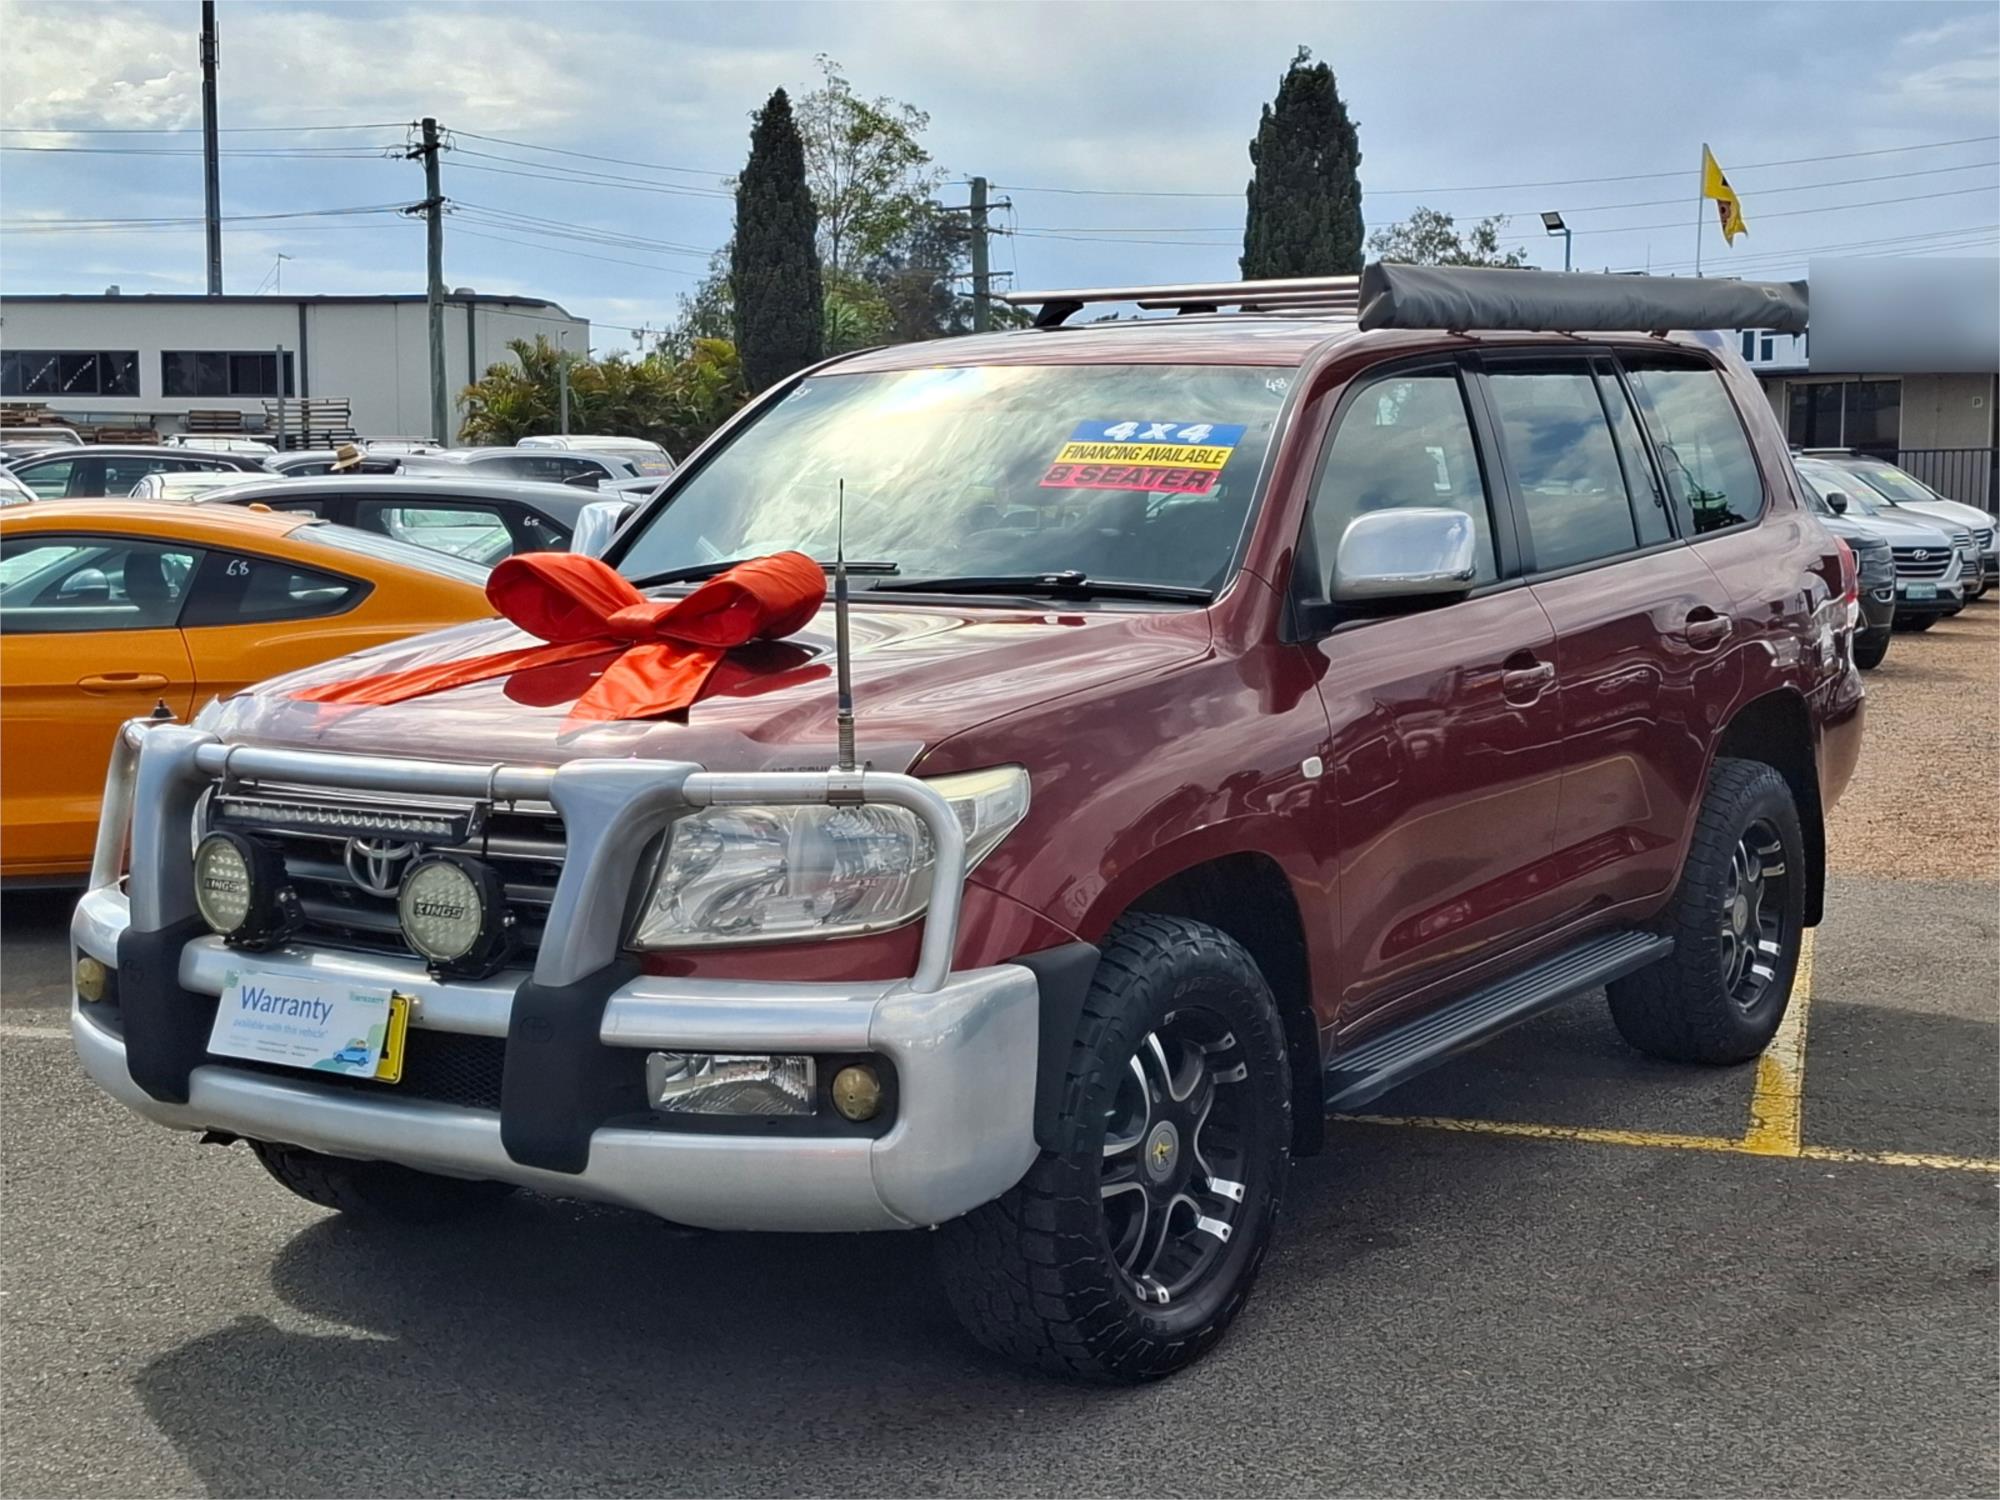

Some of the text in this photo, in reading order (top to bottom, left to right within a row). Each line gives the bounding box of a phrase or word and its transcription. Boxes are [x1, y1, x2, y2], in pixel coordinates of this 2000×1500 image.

[1266, 378, 1287, 391] 48
[1063, 445, 1227, 465] FINANCING AVAILABLE
[1046, 466, 1211, 489] 8 SEATER
[226, 560, 250, 576] 68
[416, 903, 463, 918] KINGS
[241, 985, 334, 1025] Warranty
